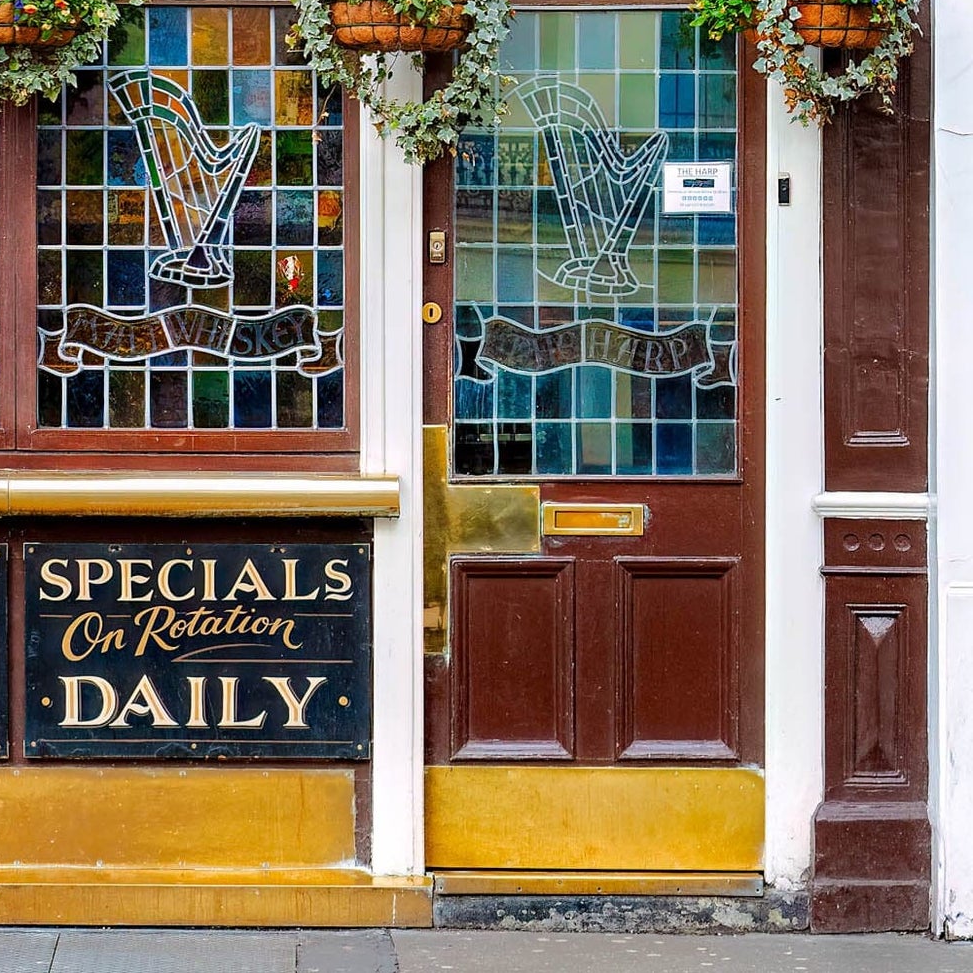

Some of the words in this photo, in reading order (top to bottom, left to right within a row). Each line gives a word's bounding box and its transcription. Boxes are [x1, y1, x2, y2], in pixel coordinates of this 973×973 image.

[588, 328, 689, 372] HARP
[39, 558, 354, 602] SPECIALS
[61, 612, 126, 662] On
[135, 605, 303, 657] Rotation
[58, 674, 328, 729] DAILY
